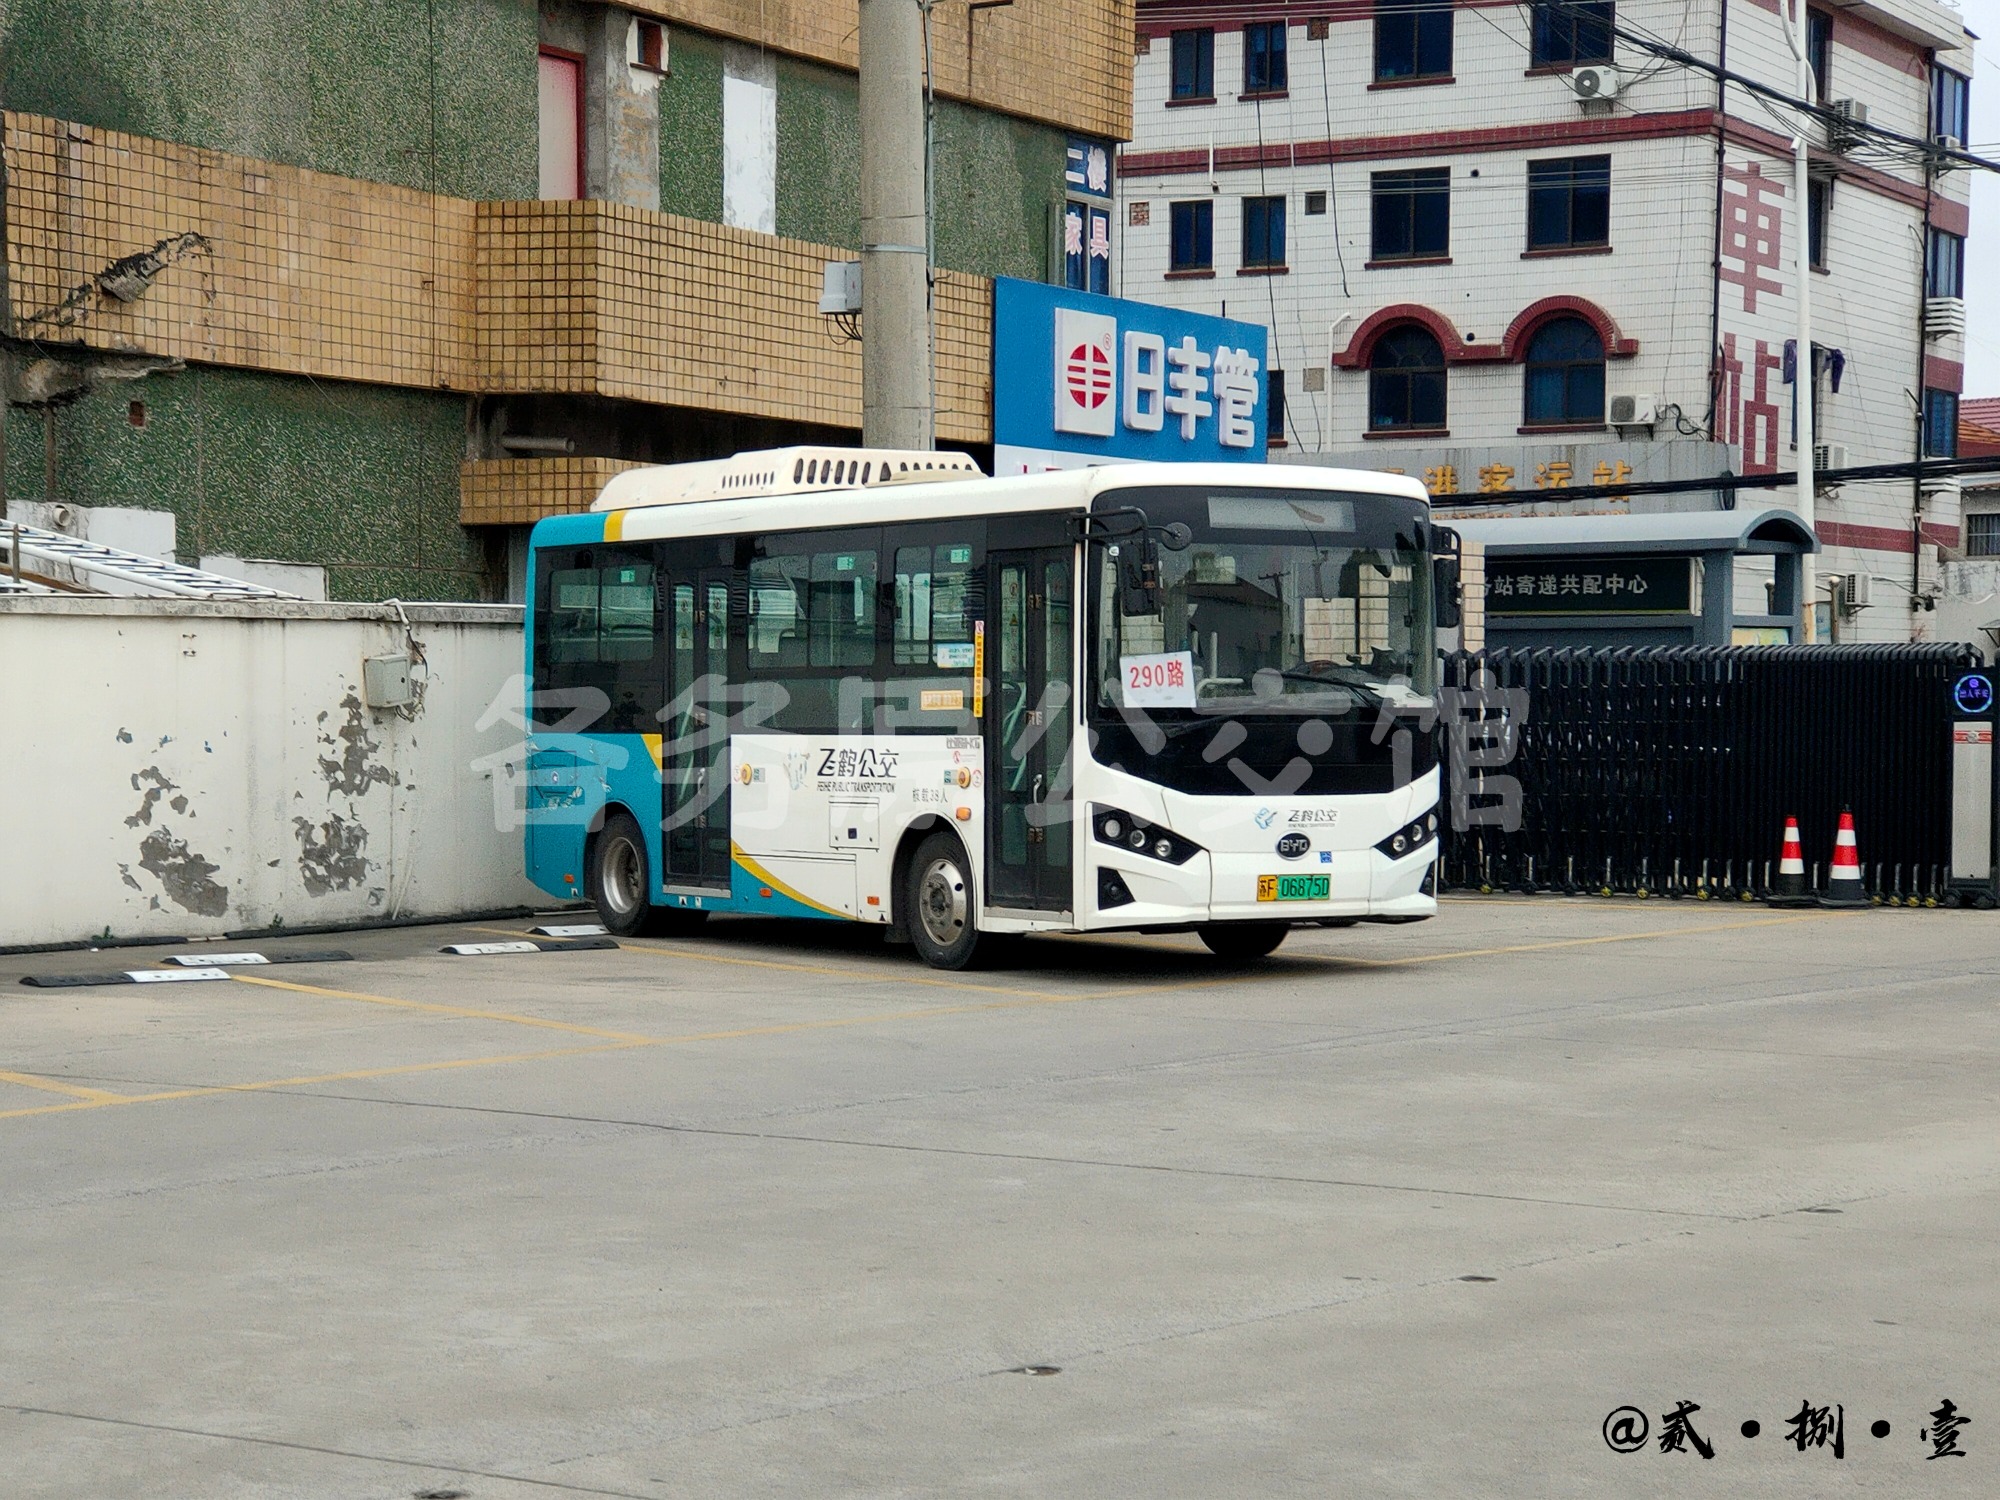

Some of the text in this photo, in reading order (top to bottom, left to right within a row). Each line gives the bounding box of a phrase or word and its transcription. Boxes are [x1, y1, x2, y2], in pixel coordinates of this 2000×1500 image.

[1065, 211, 1109, 260] 家具
[1123, 330, 1260, 448] 日丰管
[1129, 660, 1185, 689] 290路
[816, 747, 900, 779] 飞鹤公交
[1287, 808, 1339, 822] 飞鹤公交
[1280, 839, 1309, 852] BYD
